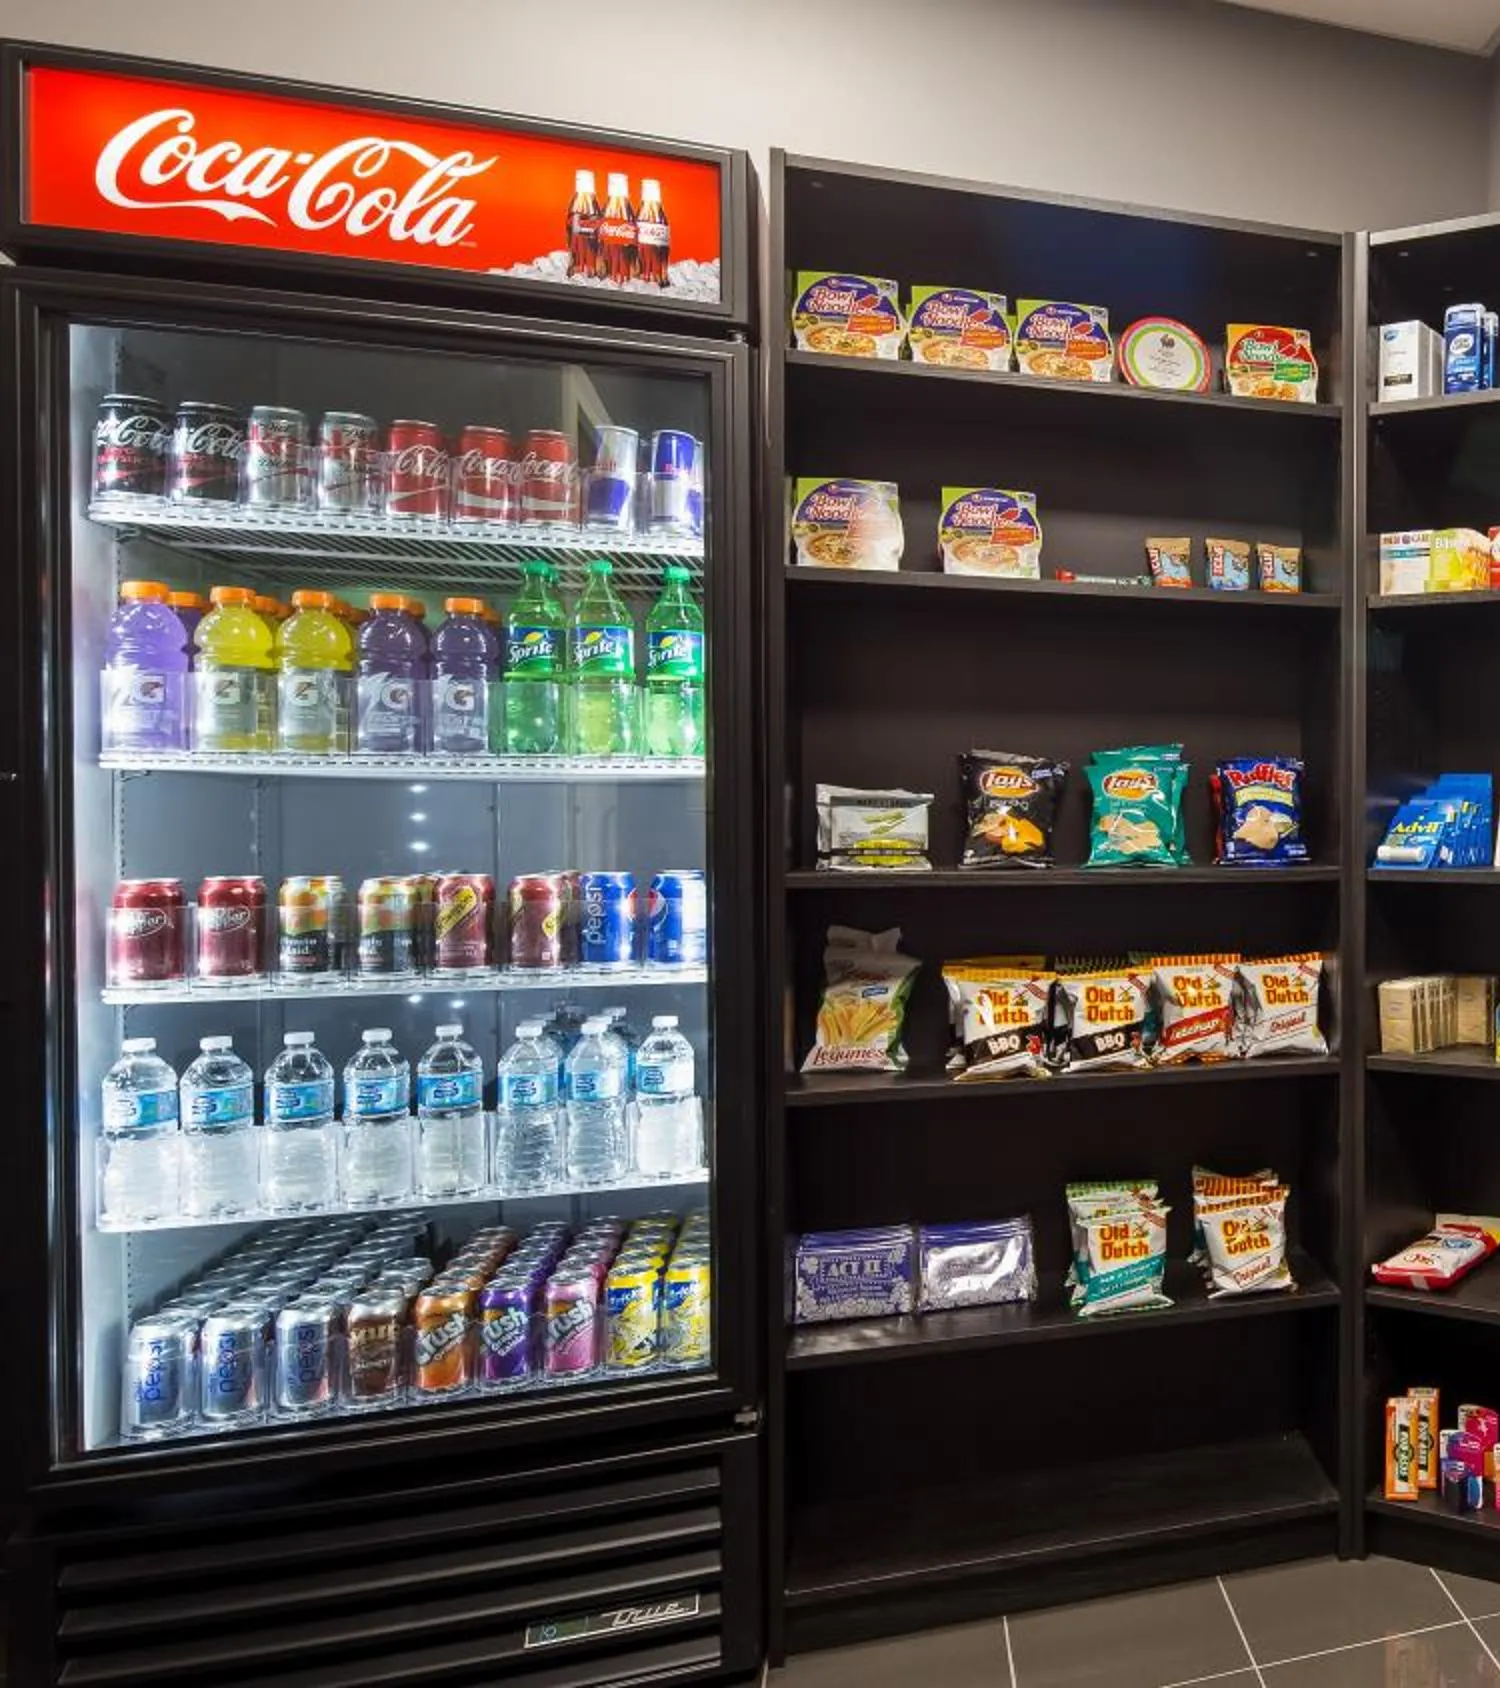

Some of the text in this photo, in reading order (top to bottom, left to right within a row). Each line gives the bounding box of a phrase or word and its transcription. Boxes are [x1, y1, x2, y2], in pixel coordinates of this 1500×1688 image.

[95, 108, 498, 248] Coca-Cola
[508, 636, 554, 658] Sprite
[1223, 763, 1296, 791] Ruffles
[583, 886, 606, 945] pepsi
[1261, 973, 1291, 990] Old
[1085, 986, 1115, 1004] Old
[1264, 988, 1310, 1007] Dutch
[1087, 1005, 1135, 1023] Dutch
[987, 1034, 1021, 1054] BBQ
[1094, 1032, 1126, 1052] BBQ
[1100, 1222, 1130, 1241] Old
[1101, 1241, 1150, 1261] Dutch
